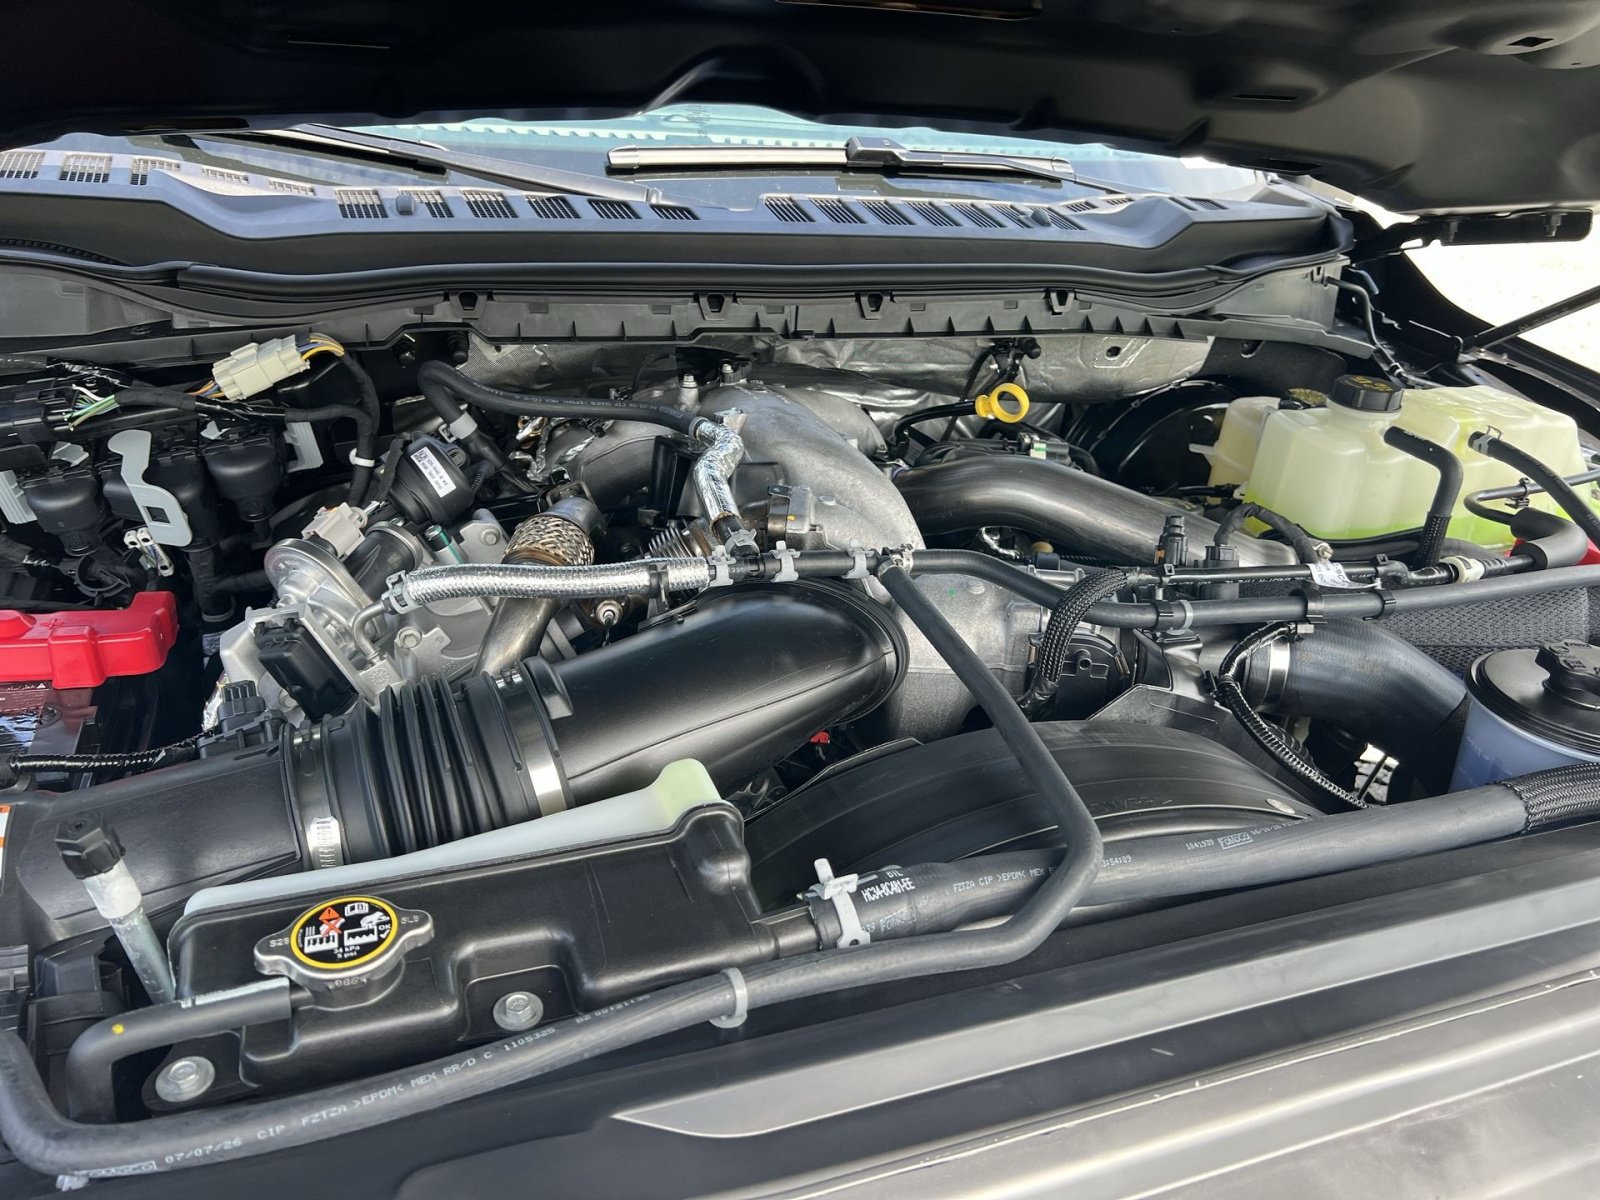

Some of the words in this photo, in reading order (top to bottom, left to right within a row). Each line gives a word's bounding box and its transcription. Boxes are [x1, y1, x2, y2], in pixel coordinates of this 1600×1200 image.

[978, 875, 994, 887] CIP
[378, 923, 391, 931] OK
[164, 1137, 243, 1165] 07/07/26
[256, 1123, 286, 1141] CIP
[410, 1071, 437, 1088] MEX
[483, 1051, 493, 1060] C
